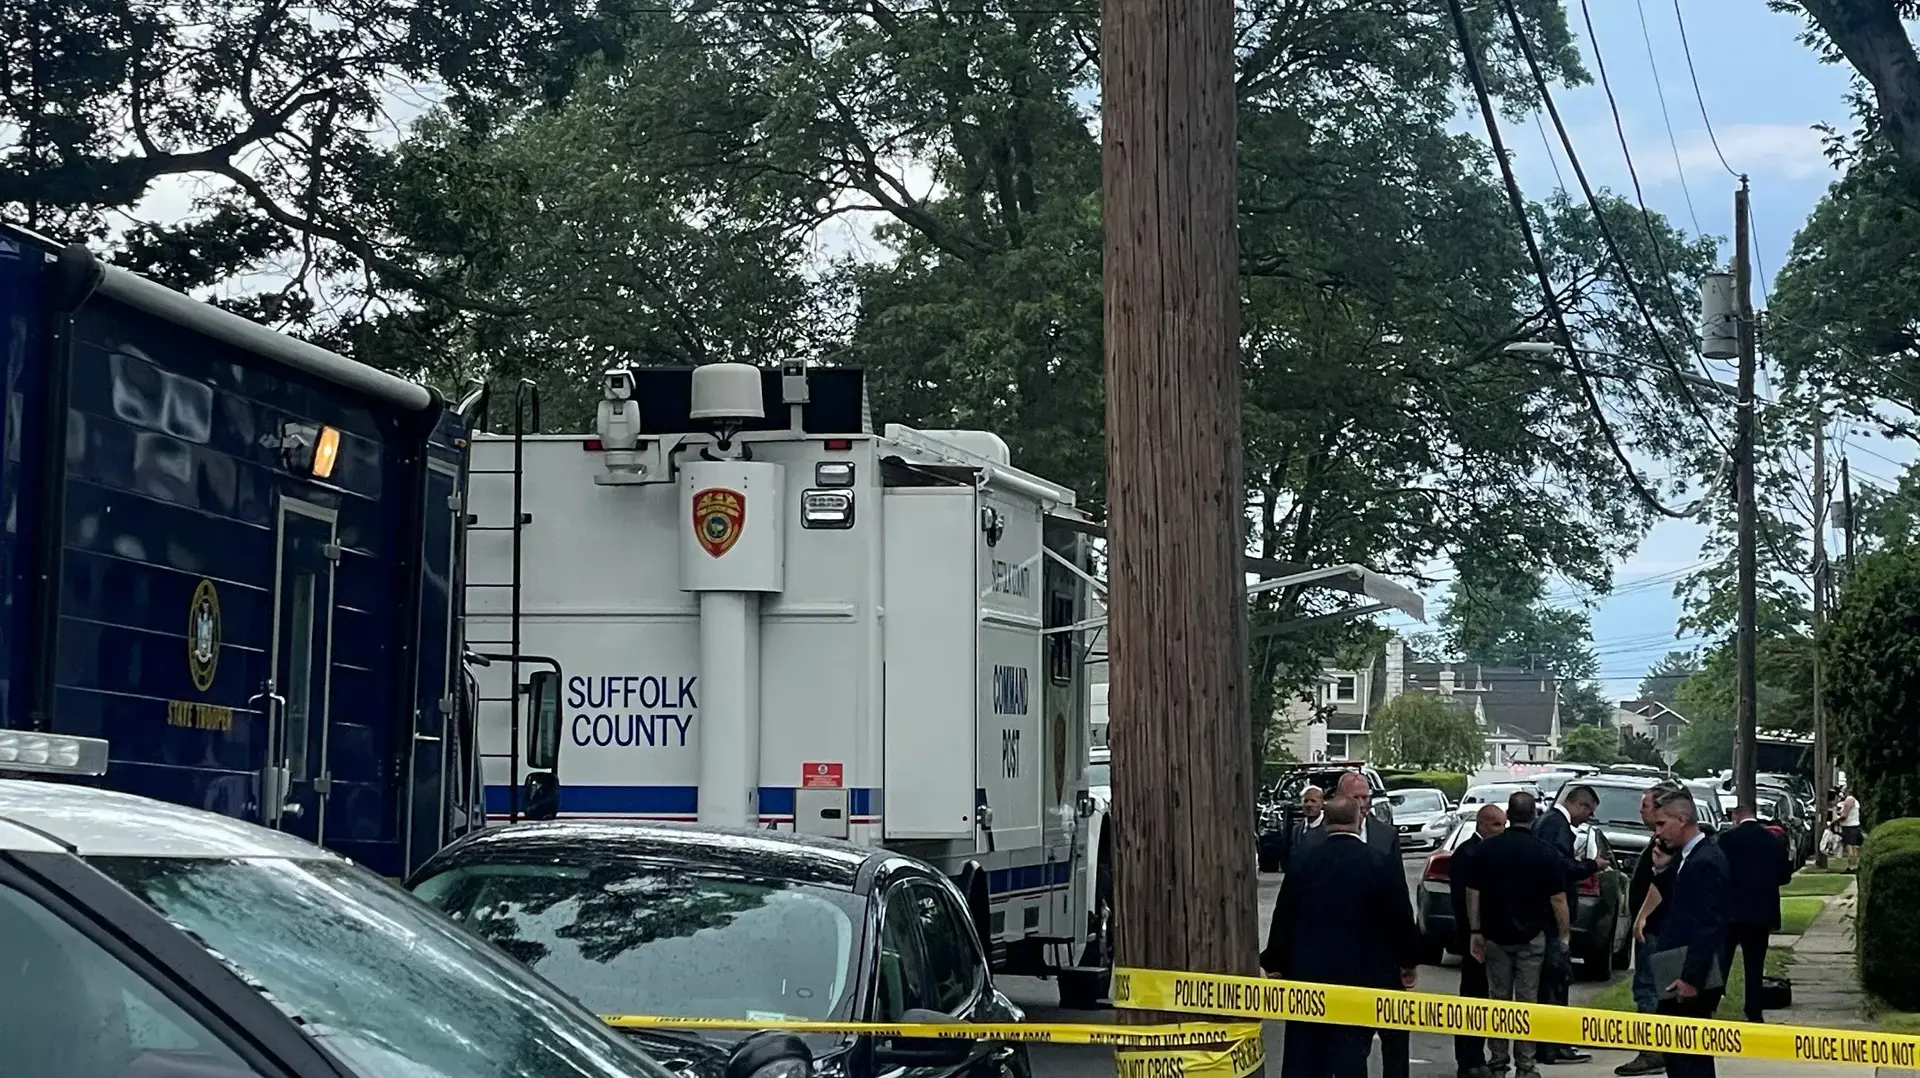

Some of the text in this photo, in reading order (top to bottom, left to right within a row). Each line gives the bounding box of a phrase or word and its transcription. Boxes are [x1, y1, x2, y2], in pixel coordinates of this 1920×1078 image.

[567, 675, 698, 709] SUFFOLK
[993, 664, 1029, 715] COMMAND
[167, 700, 233, 731] STATE TROOPER
[572, 714, 693, 747] COUNTY
[1002, 729, 1020, 778] POST
[1174, 979, 1326, 1017] POLICE LINE DO NOT CROSS
[1376, 997, 1531, 1035] POLICE LINE DO NOT CROSS
[1582, 1016, 1742, 1053] POLICE LINE DO NOT CROSS
[1795, 1035, 1915, 1066] POLICE LINE DO NOT
[1148, 1057, 1184, 1078] CROSS
[1230, 1036, 1259, 1074] POLICE
